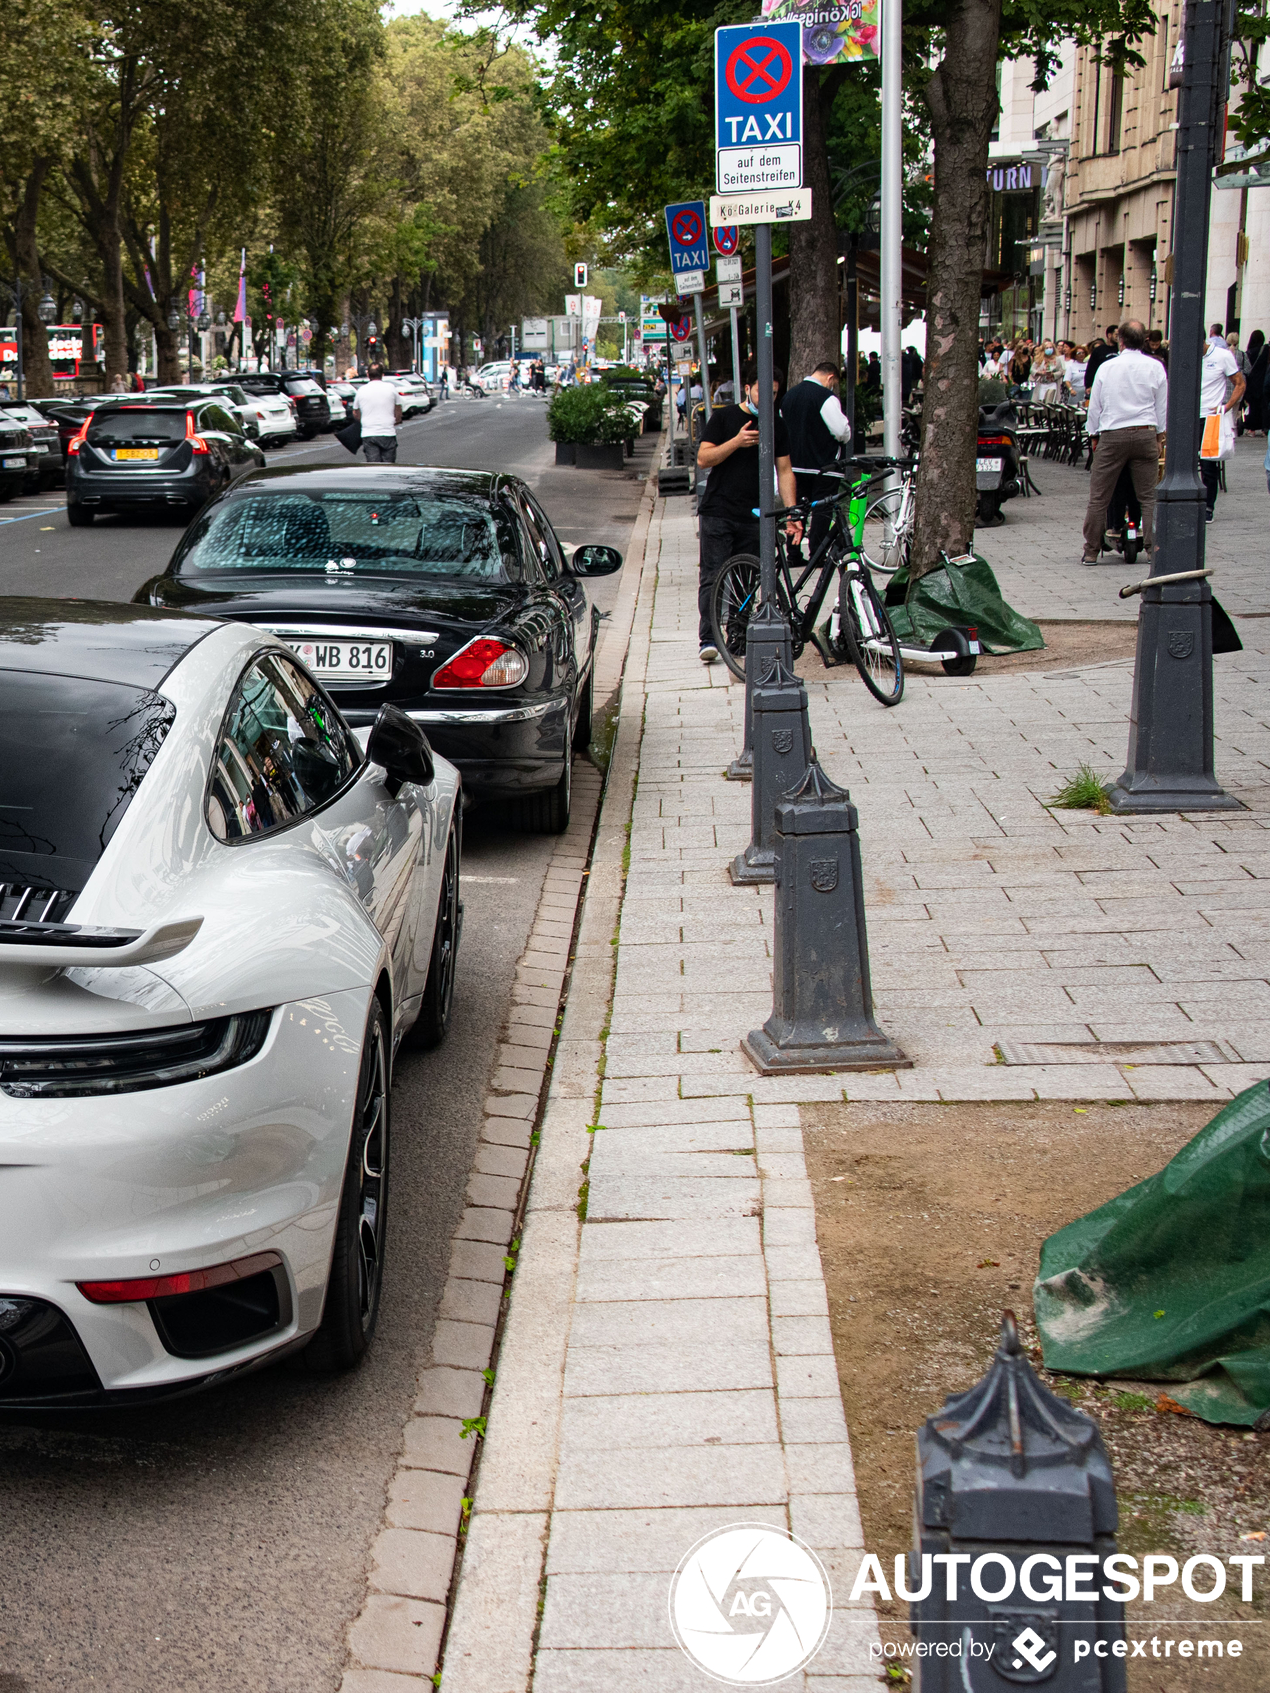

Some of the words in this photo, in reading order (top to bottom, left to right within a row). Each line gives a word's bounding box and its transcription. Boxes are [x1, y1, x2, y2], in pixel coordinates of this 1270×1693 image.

[725, 112, 792, 143] TAXI
[737, 156, 754, 168] auf
[759, 155, 781, 167] dem
[724, 170, 795, 186] Seitenstreifen
[720, 202, 775, 217] Kö-Galerie
[674, 250, 705, 267] TAXI
[316, 645, 341, 668] WB
[348, 647, 386, 669] 816
[419, 650, 435, 659] 3.0
